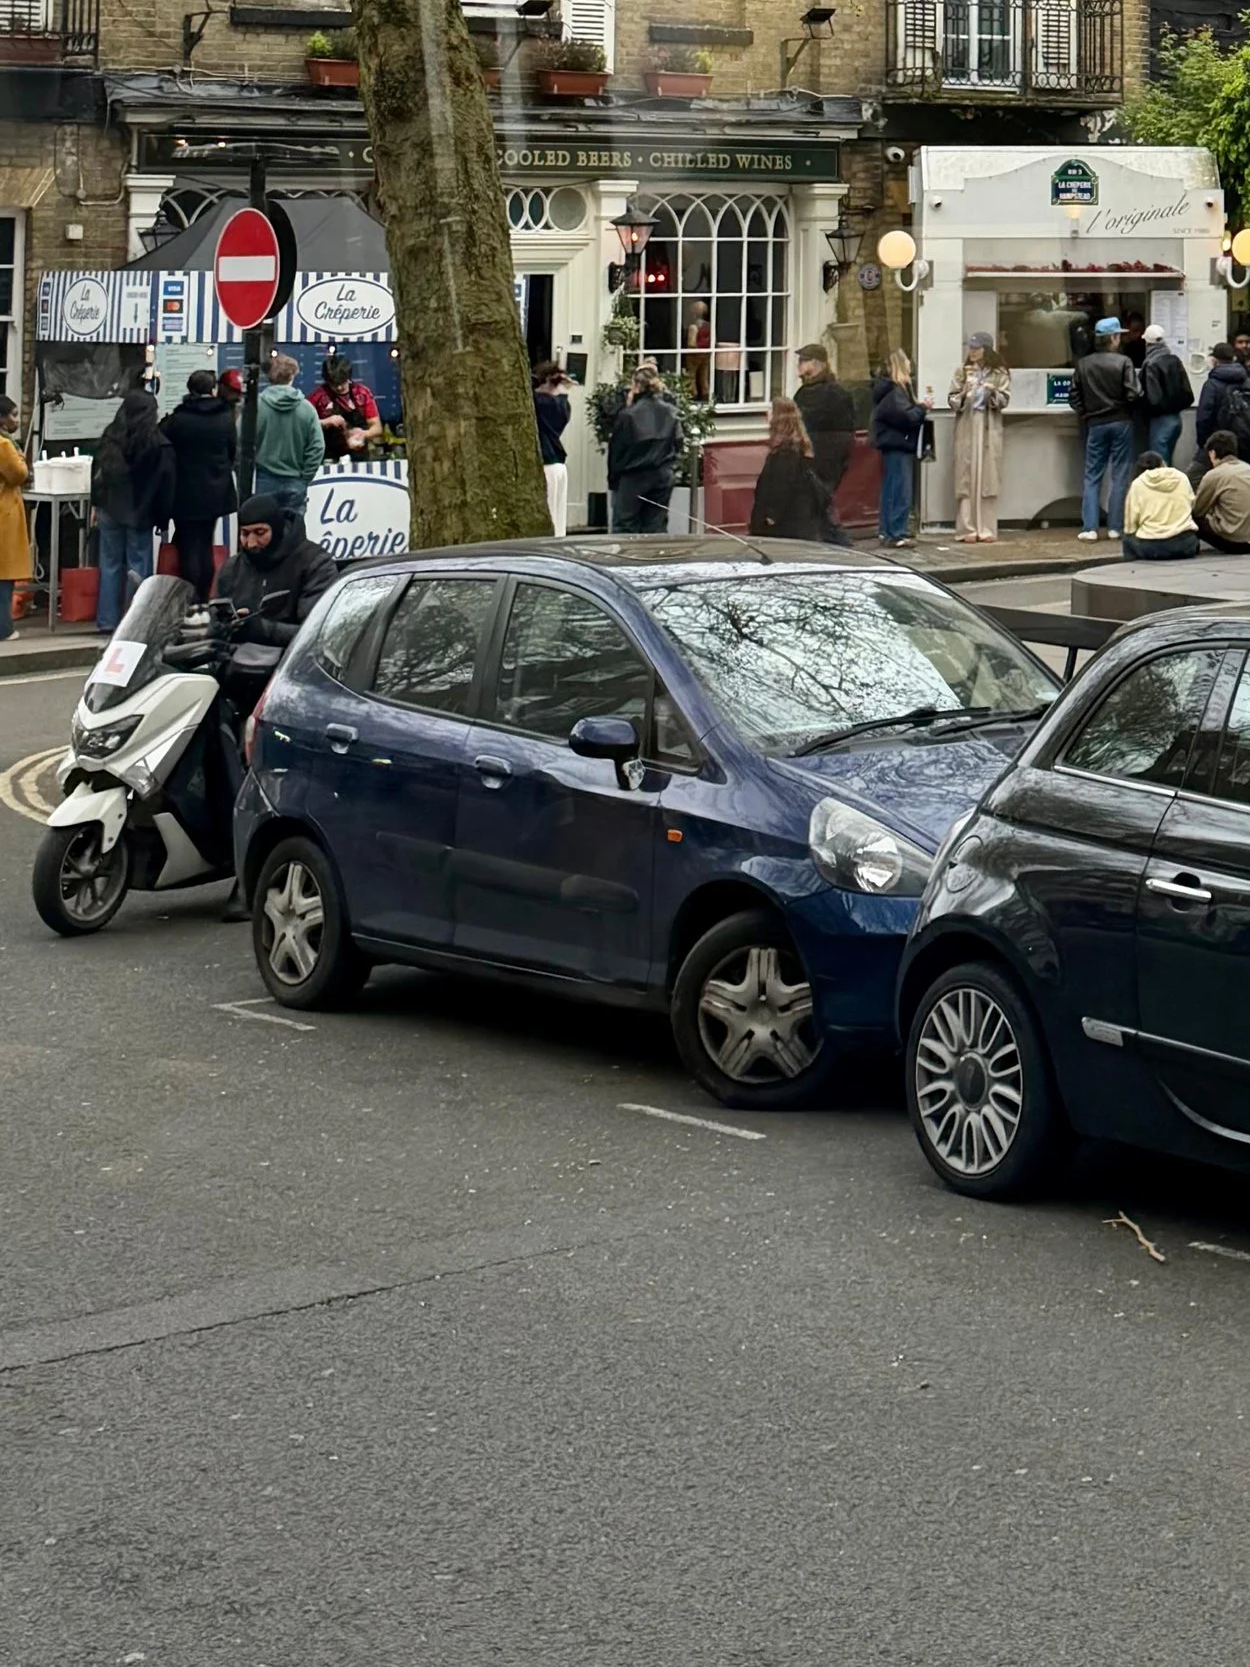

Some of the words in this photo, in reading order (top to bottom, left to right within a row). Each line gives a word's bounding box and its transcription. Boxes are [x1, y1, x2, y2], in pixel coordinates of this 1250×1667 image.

[576, 150, 632, 168] BEERS
[649, 152, 731, 169] CHILLED
[735, 153, 793, 170] WINES
[1086, 190, 1191, 234] l'originale
[81, 284, 90, 301] La
[336, 284, 357, 301] La
[320, 487, 358, 525] La
[320, 528, 408, 559] êperie
[104, 647, 125, 673] L
